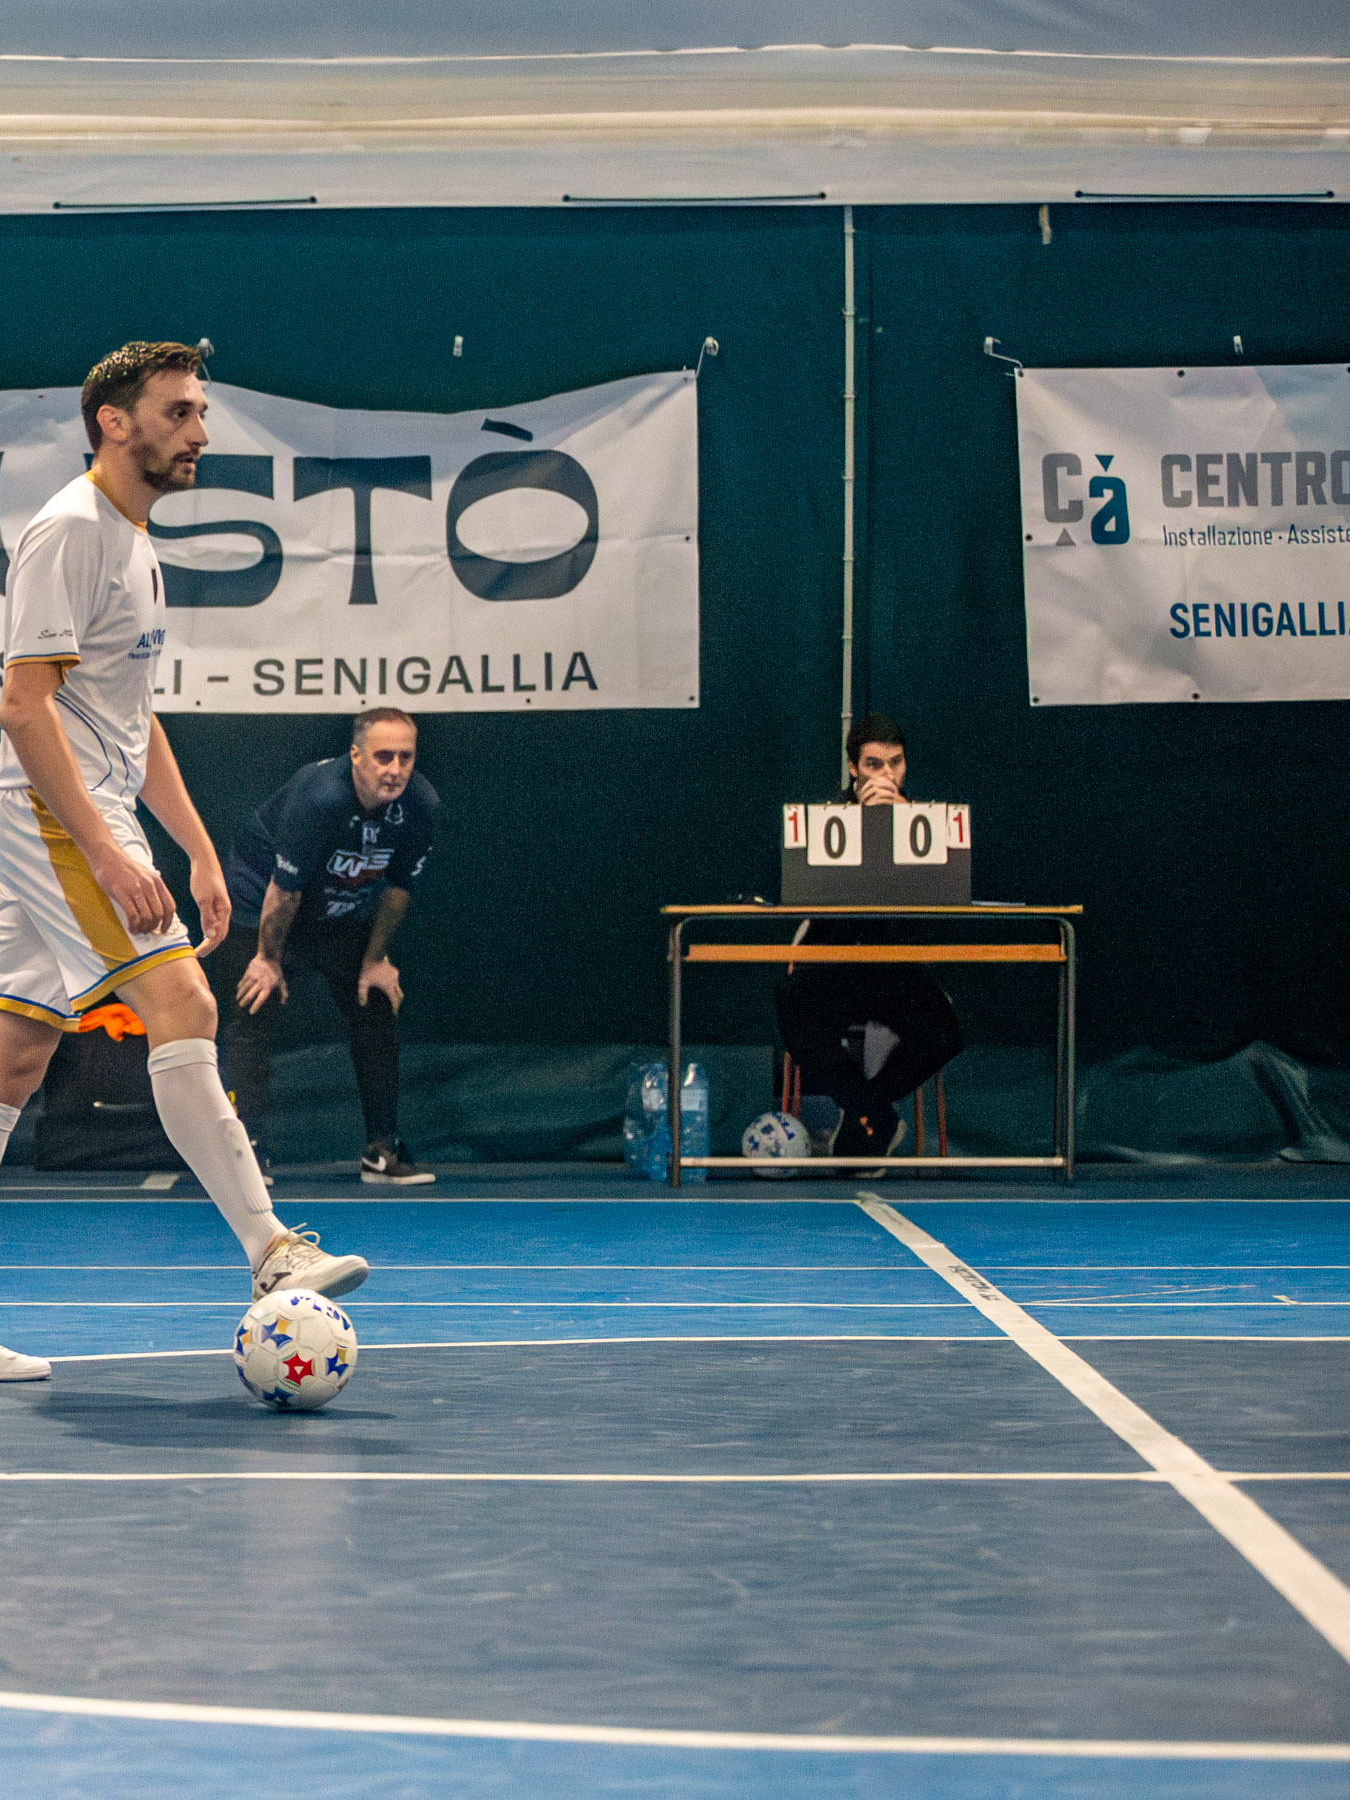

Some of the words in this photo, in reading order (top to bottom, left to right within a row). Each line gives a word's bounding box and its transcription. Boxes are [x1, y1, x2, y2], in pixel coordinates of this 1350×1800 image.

[1163, 525, 1273, 547] Installazione
[1169, 601, 1350, 639] SENIGALLI
[252, 651, 598, 697] SENIGALLIA
[788, 811, 799, 843] 1
[823, 815, 846, 859] 0
[909, 814, 932, 858] 0
[953, 811, 964, 843] 1
